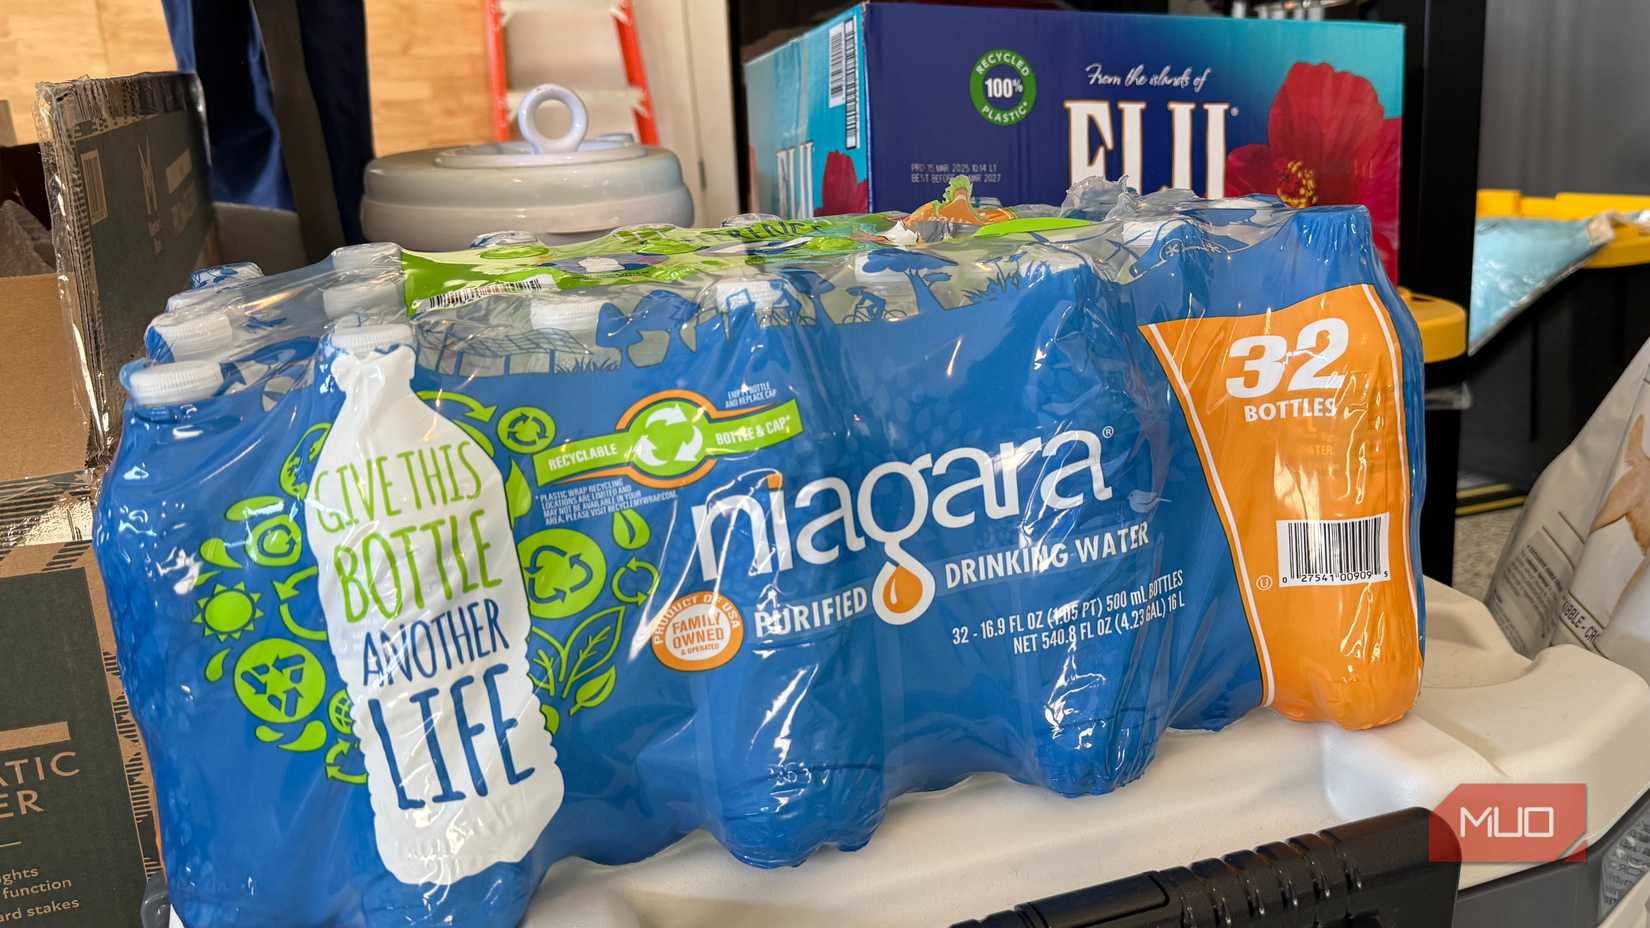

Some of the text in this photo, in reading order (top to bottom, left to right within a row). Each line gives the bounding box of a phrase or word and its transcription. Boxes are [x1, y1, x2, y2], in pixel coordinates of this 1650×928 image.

[975, 52, 1030, 76] RECYCLED
[1085, 63, 1212, 93] From the islands of
[984, 77, 1024, 98] 100%
[1226, 318, 1349, 399] 32
[1243, 397, 1338, 423] BOTTLES
[548, 444, 618, 472] RECYCLABLE
[714, 426, 756, 447] BOTTLE
[314, 440, 483, 535] GIVE THIS
[690, 428, 1113, 626] niagara
[333, 508, 503, 624] BOTTLE
[944, 521, 1150, 589] DRINKING WATER
[1282, 576, 1288, 584] 0
[1301, 574, 1335, 583] 27541
[1339, 571, 1373, 582] 00909
[672, 611, 722, 635] FAMILY
[722, 602, 741, 628] USA
[754, 587, 868, 638] PURIFIED
[952, 626, 969, 645] 32
[980, 618, 1006, 640] 16.9
[1009, 614, 1024, 633] FL
[1027, 610, 1044, 631] OZ
[1081, 597, 1103, 618] PT)
[1106, 592, 1127, 612] 500
[1130, 585, 1148, 606] mL
[1148, 569, 1184, 599] BOTTLES
[1013, 634, 1039, 655] NET
[1041, 627, 1077, 649] 540.8
[1080, 621, 1095, 640] FL
[1097, 616, 1113, 636] OZ
[1115, 609, 1145, 635] (4.23
[1145, 598, 1166, 622] GAL)
[1168, 594, 1177, 613] 16
[362, 598, 510, 688] ANOTHER
[673, 627, 724, 649] OWNED
[367, 662, 536, 811] LIFE
[0, 751, 81, 787] TIC
[3, 878, 72, 899] function
[27, 898, 80, 918] stakes
